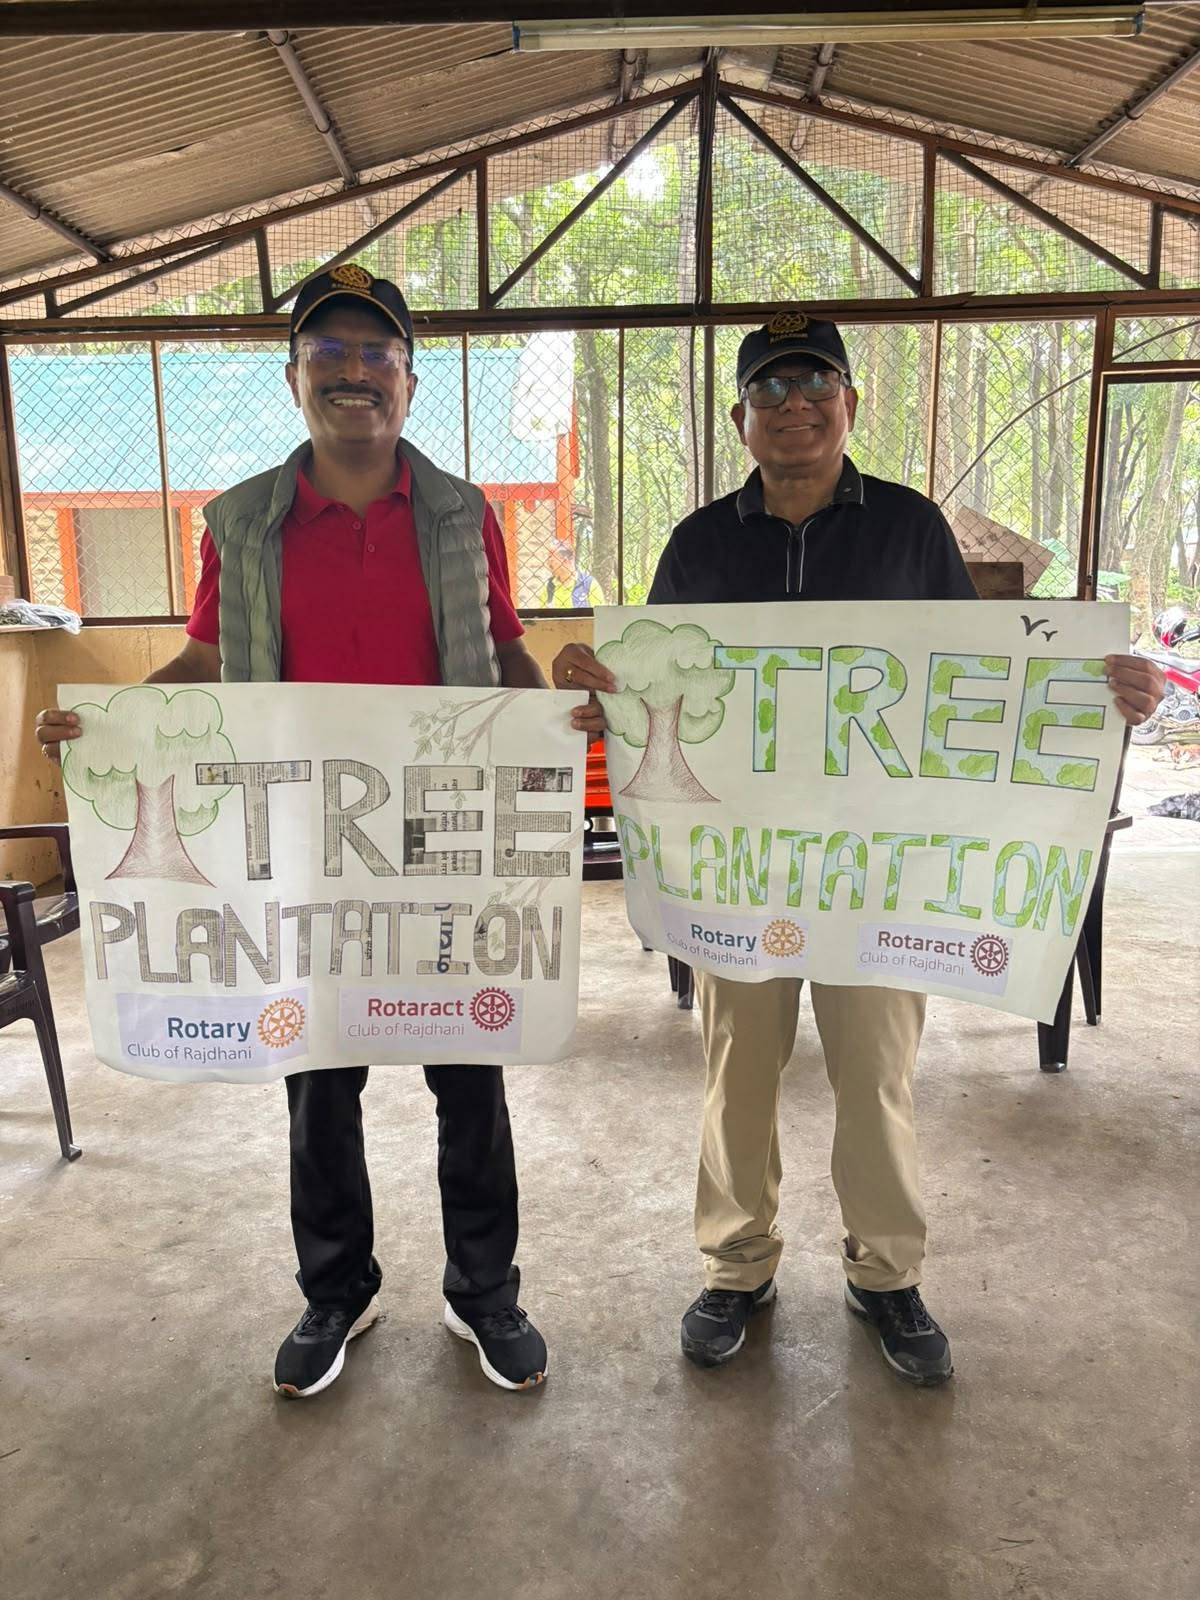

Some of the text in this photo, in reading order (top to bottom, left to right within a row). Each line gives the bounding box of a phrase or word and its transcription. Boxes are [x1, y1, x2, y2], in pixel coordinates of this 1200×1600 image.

[714, 645, 1109, 792] TREE
[195, 759, 574, 881] TREE
[618, 813, 1093, 938] PLANTATION
[89, 900, 563, 987] PLANTATION
[691, 924, 757, 952] Rotary
[878, 931, 966, 957] Rotaract
[690, 943, 702, 957] of
[703, 947, 758, 967] Rajdhani
[860, 951, 965, 977] Club of Rajdhani
[367, 998, 465, 1017] Rotaract
[168, 1017, 251, 1042] Rotary
[347, 1022, 465, 1039] Club of Rajdhani
[127, 1043, 252, 1063] Club of Rajdhani
